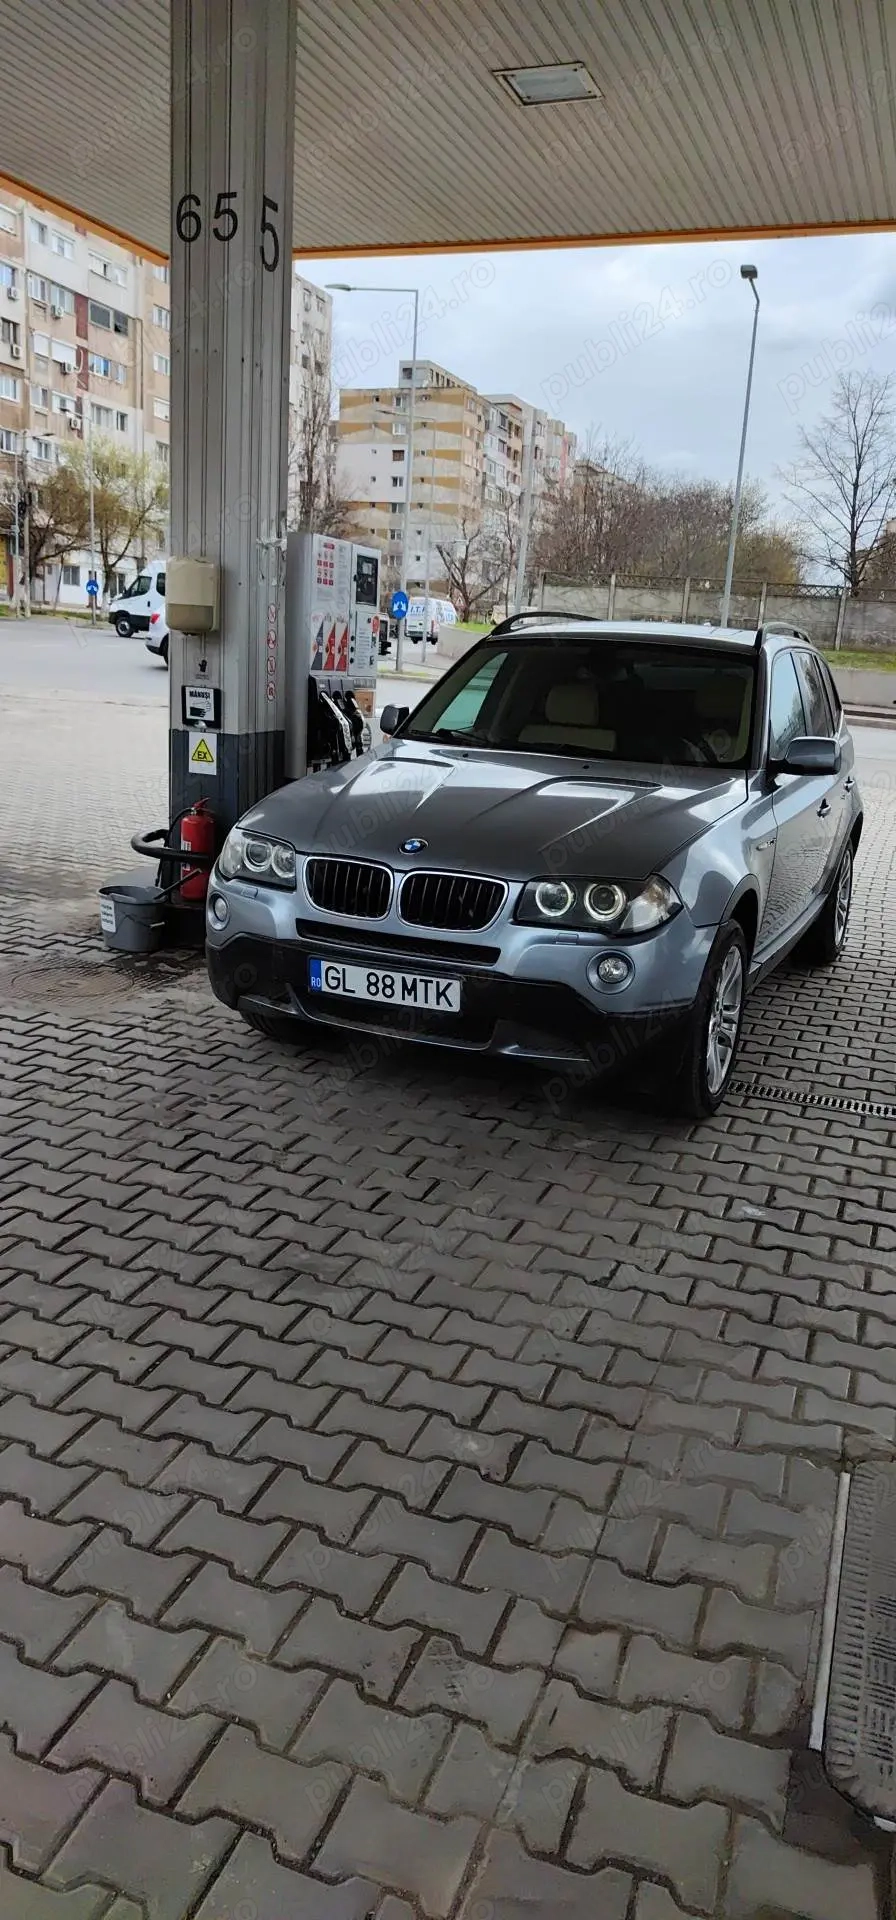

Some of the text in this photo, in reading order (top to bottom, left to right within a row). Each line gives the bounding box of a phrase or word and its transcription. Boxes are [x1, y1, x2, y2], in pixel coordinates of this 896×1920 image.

[197, 751, 208, 760] EX
[311, 966, 453, 1007] RO GL 88 MTK
